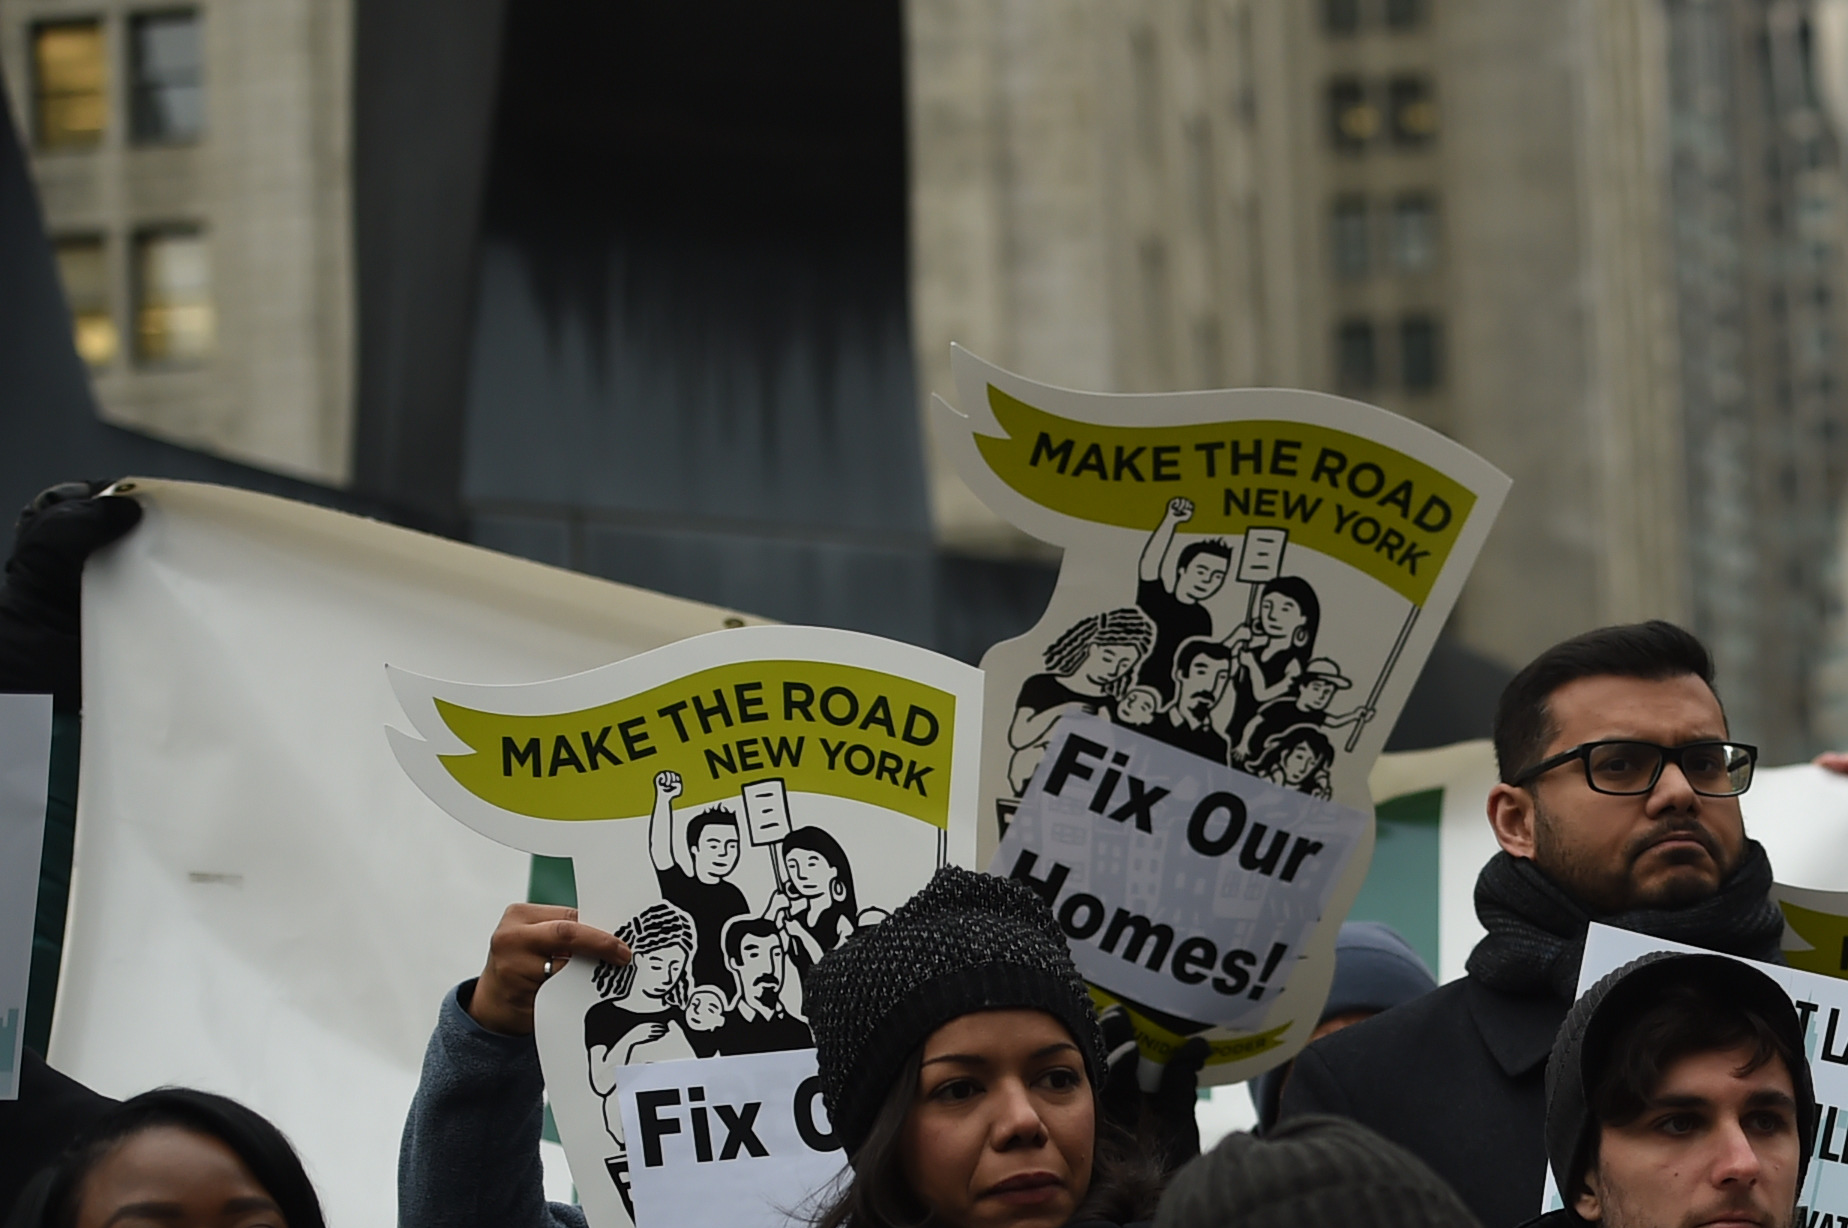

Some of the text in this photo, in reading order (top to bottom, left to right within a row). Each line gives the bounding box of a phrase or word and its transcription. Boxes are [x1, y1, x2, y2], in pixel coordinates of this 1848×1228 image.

[1029, 432, 1451, 533] MAKE THE ROAD
[1224, 488, 1431, 576] NEW YORK
[501, 681, 939, 778] MAKE THE ROAD
[704, 737, 934, 797] NEW YORK
[1043, 733, 1323, 883] Fix Our
[635, 1086, 770, 1168] Fix
